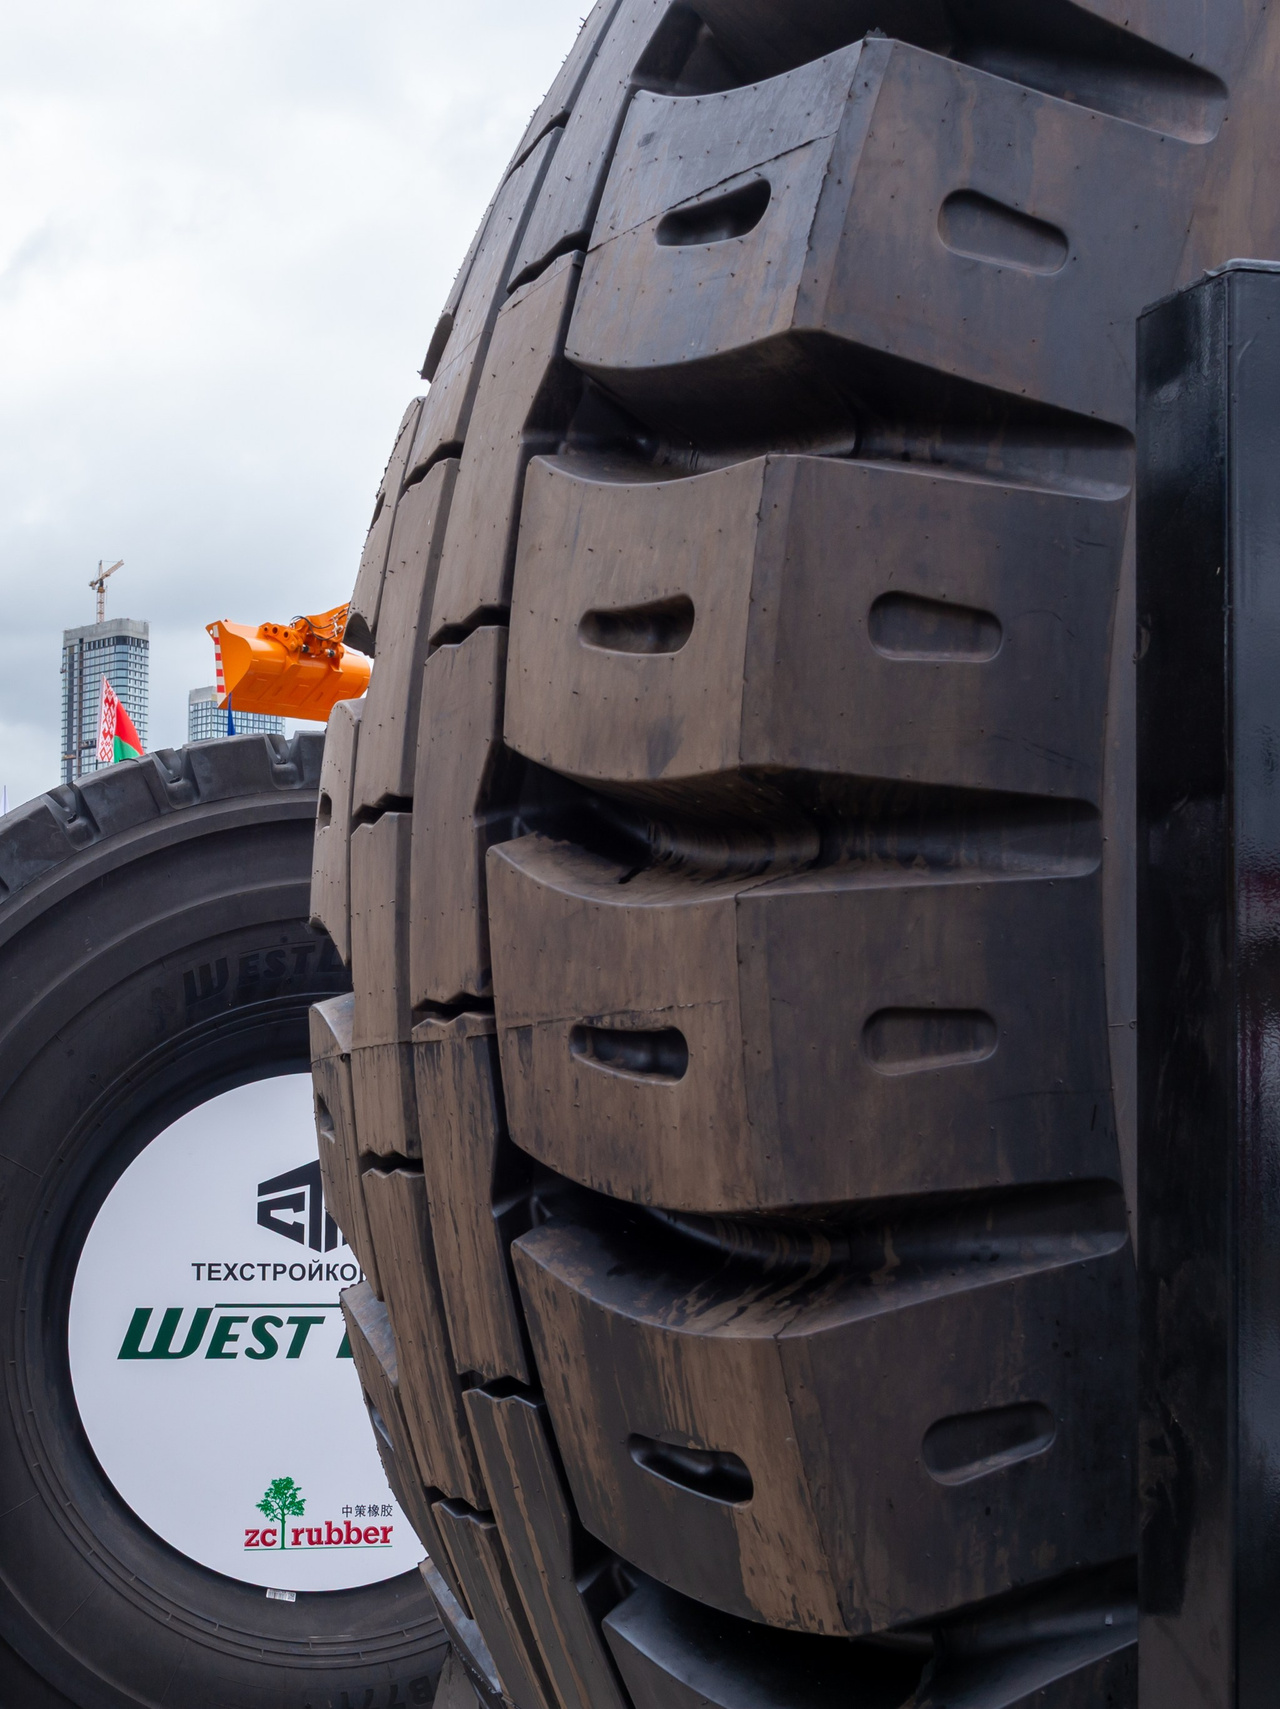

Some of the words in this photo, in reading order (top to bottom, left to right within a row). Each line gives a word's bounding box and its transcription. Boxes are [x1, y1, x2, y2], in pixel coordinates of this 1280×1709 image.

[117, 1307, 326, 1360] WEST
[341, 1504, 393, 1518] 中策橡胶
[244, 1528, 277, 1547] zc
[291, 1520, 393, 1546] rubber
